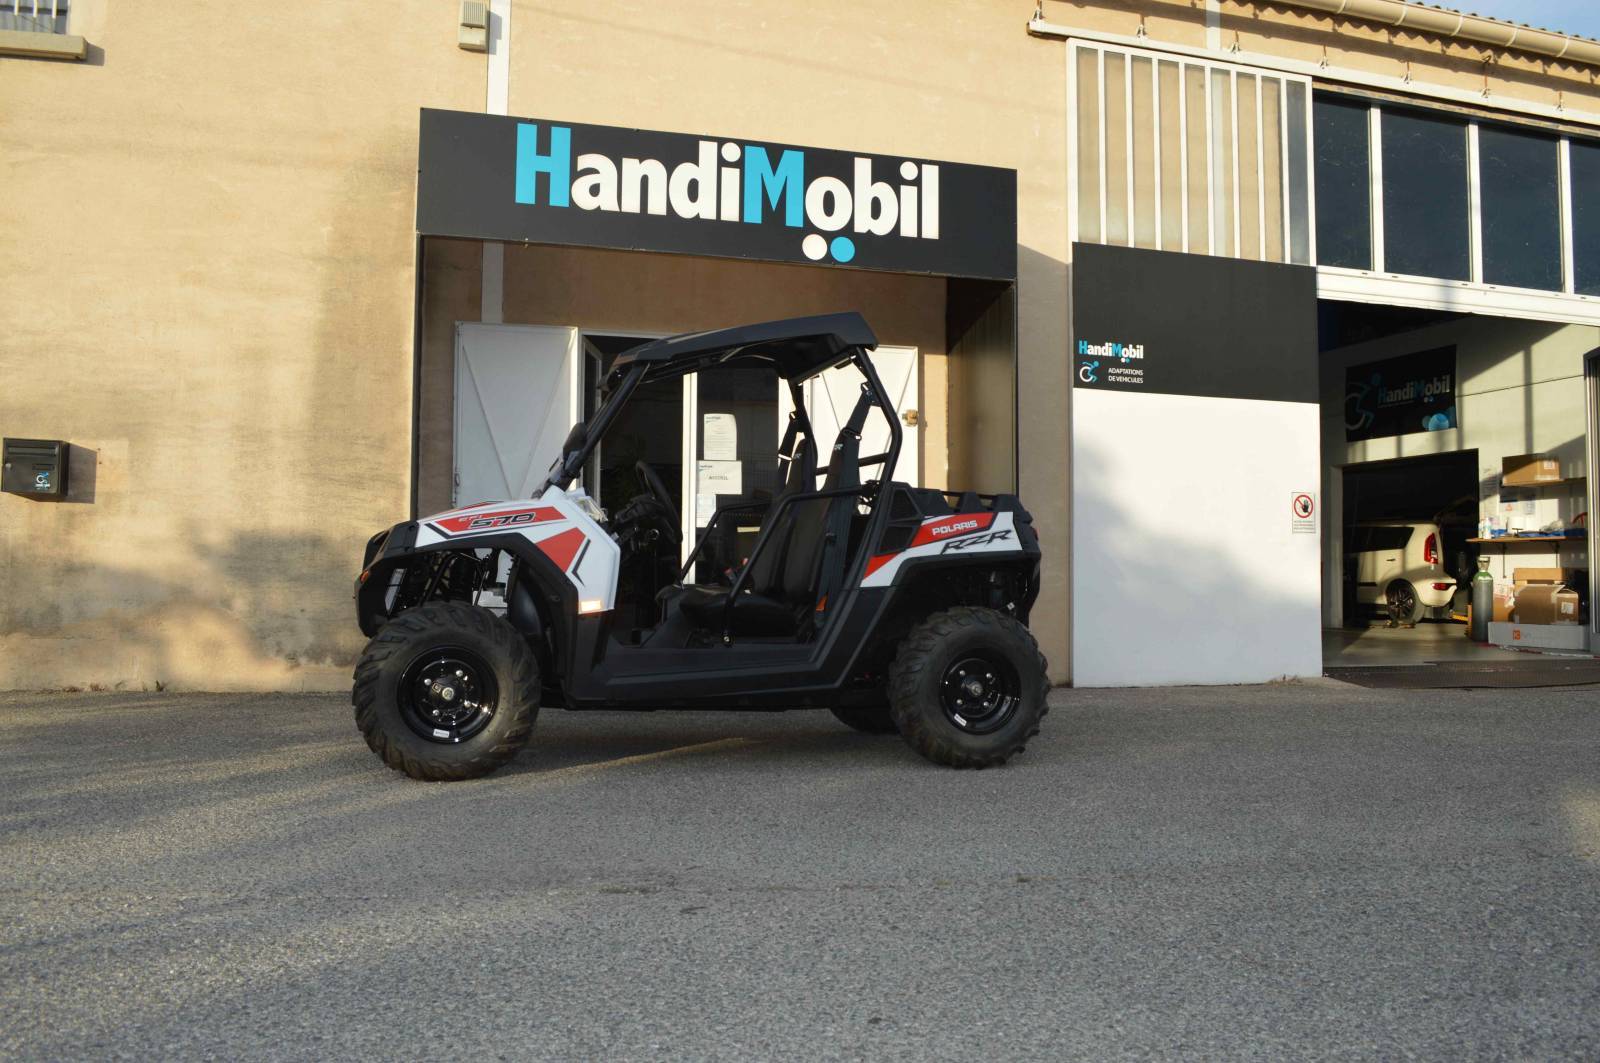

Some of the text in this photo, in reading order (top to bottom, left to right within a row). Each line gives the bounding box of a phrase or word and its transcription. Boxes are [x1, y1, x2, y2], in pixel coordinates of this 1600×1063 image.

[515, 123, 939, 239] HandiMobil
[1079, 340, 1144, 359] HandiMobil
[1108, 367, 1144, 376] ADAPTATIONS
[469, 512, 536, 530] 570
[932, 520, 978, 536] POLARIS
[941, 529, 1012, 555] RZR
